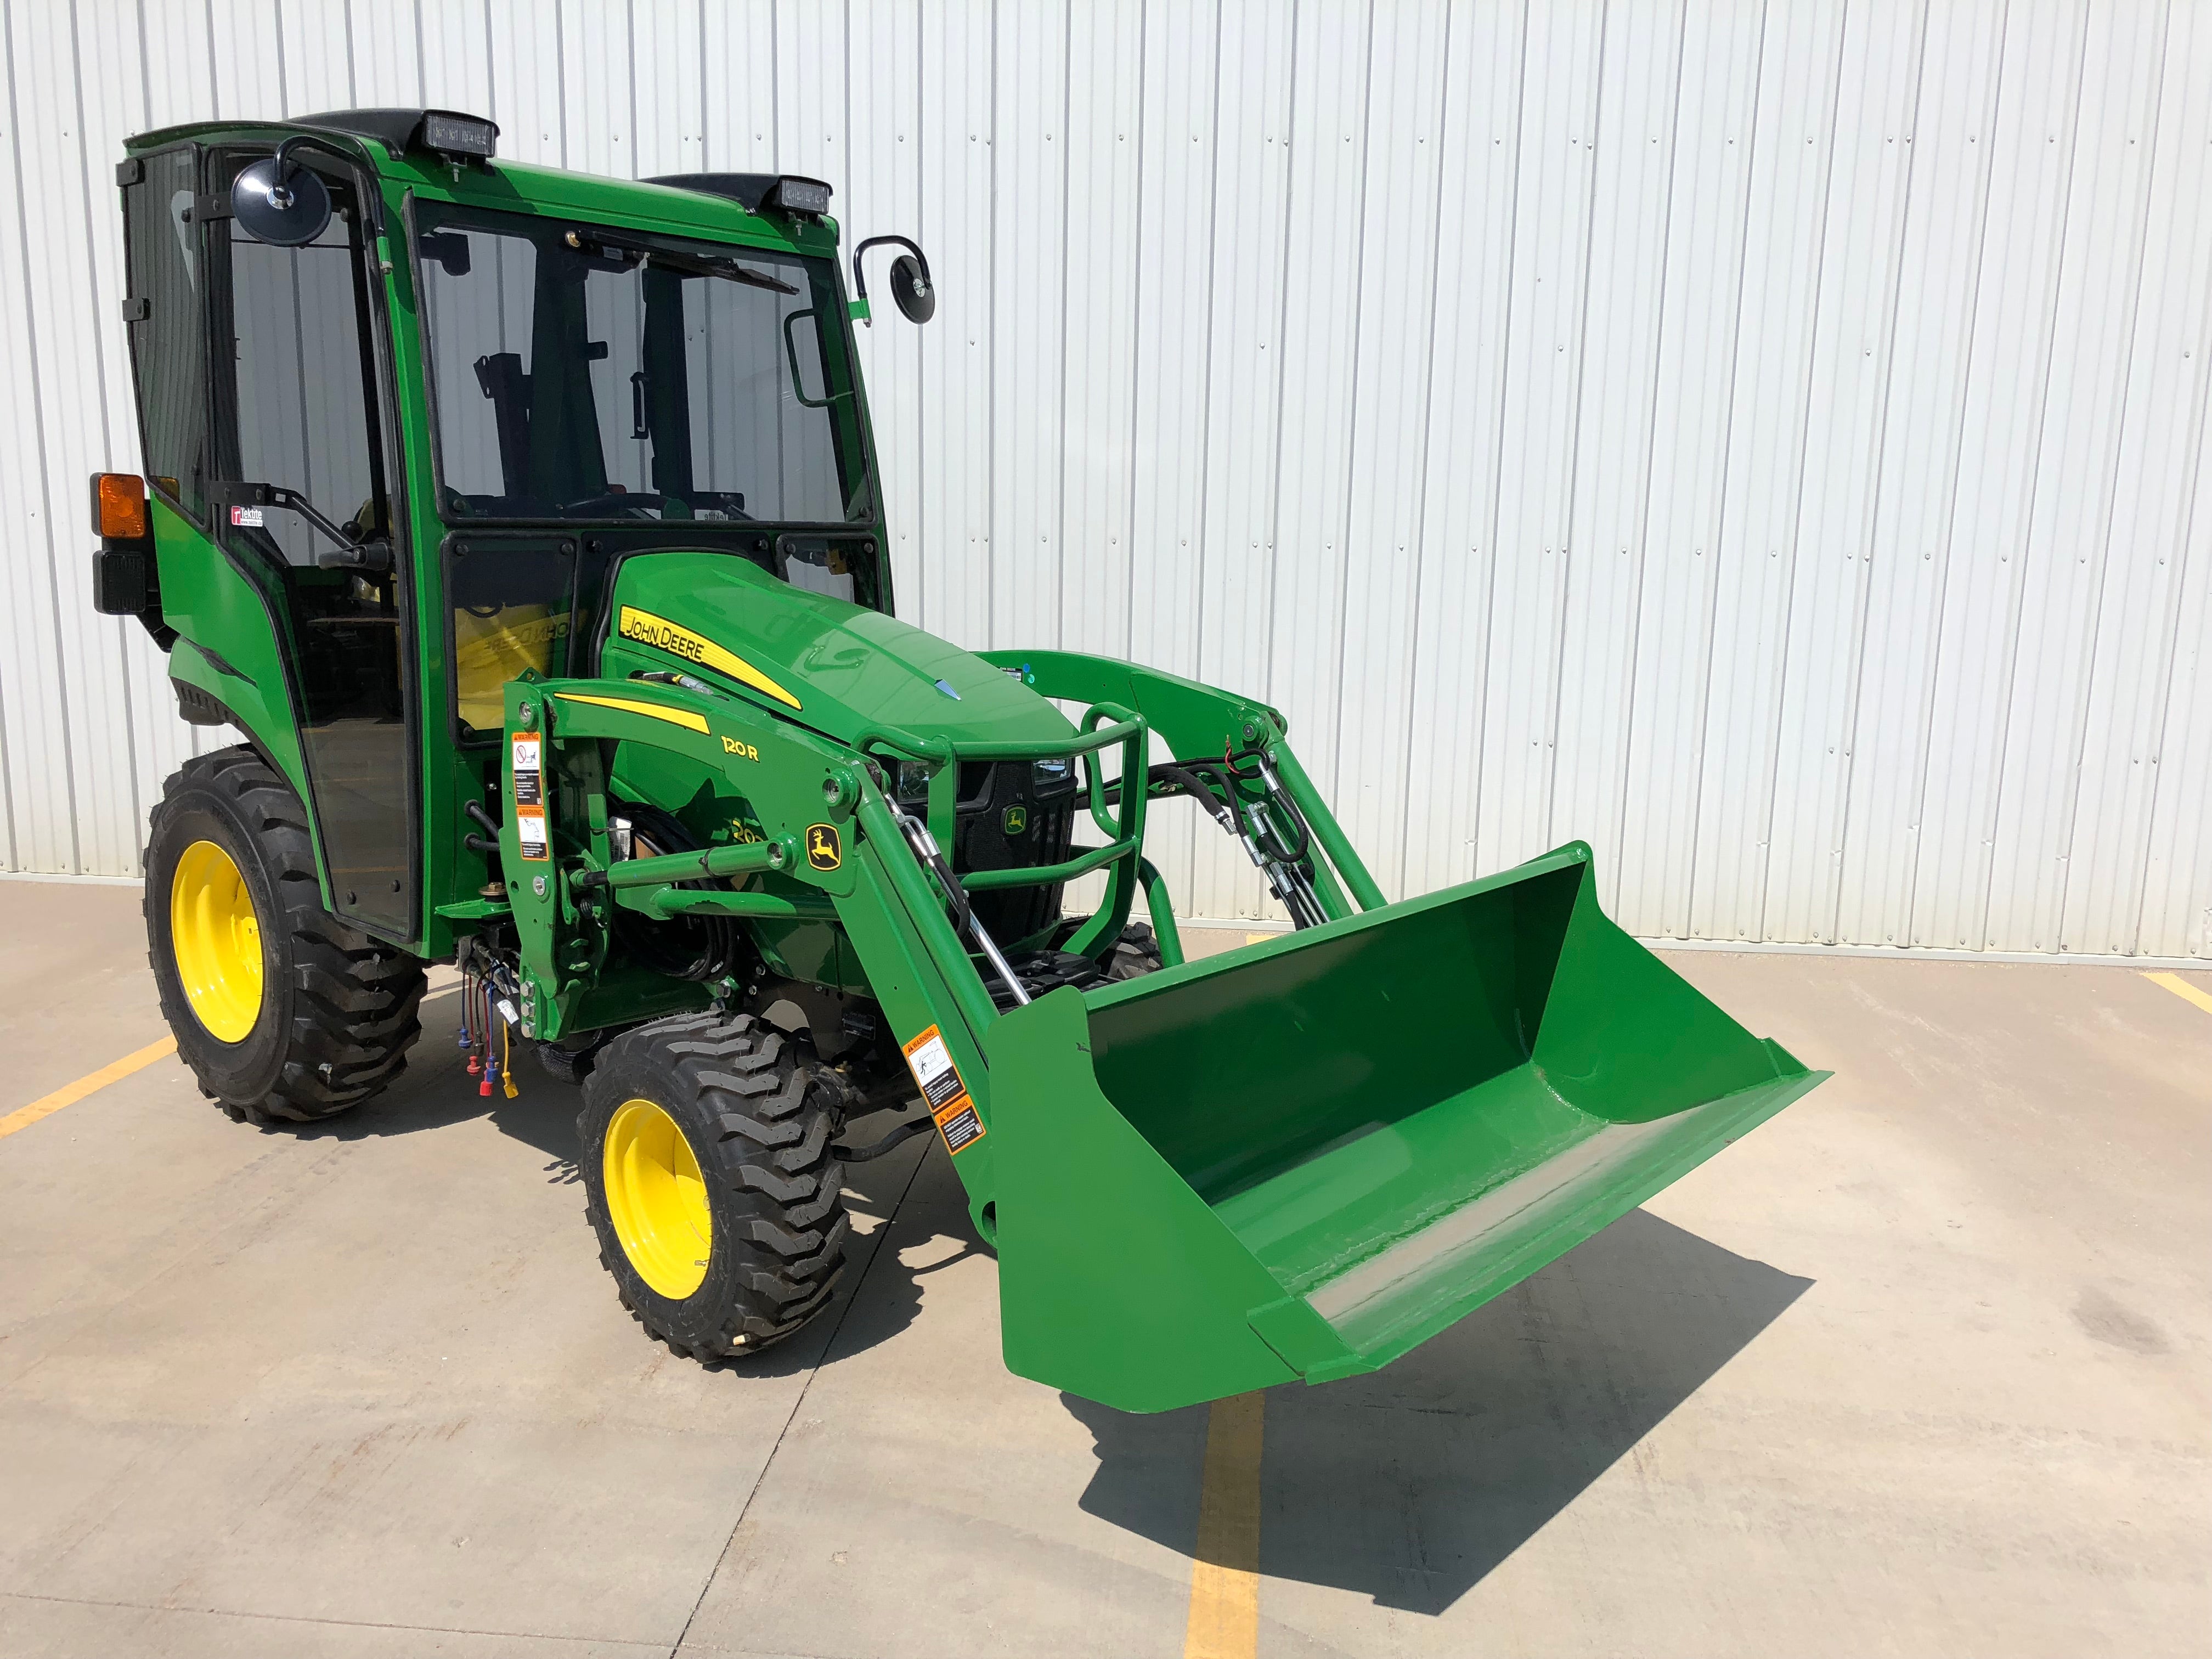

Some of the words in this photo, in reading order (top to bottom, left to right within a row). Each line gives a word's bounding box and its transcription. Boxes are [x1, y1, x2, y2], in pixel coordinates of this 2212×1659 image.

[241, 507, 262, 520] Tektite
[627, 617, 659, 643] JOHN
[661, 627, 704, 660] DEERE
[912, 1029, 934, 1048] WARNING
[945, 1101, 968, 1118] WARNING
